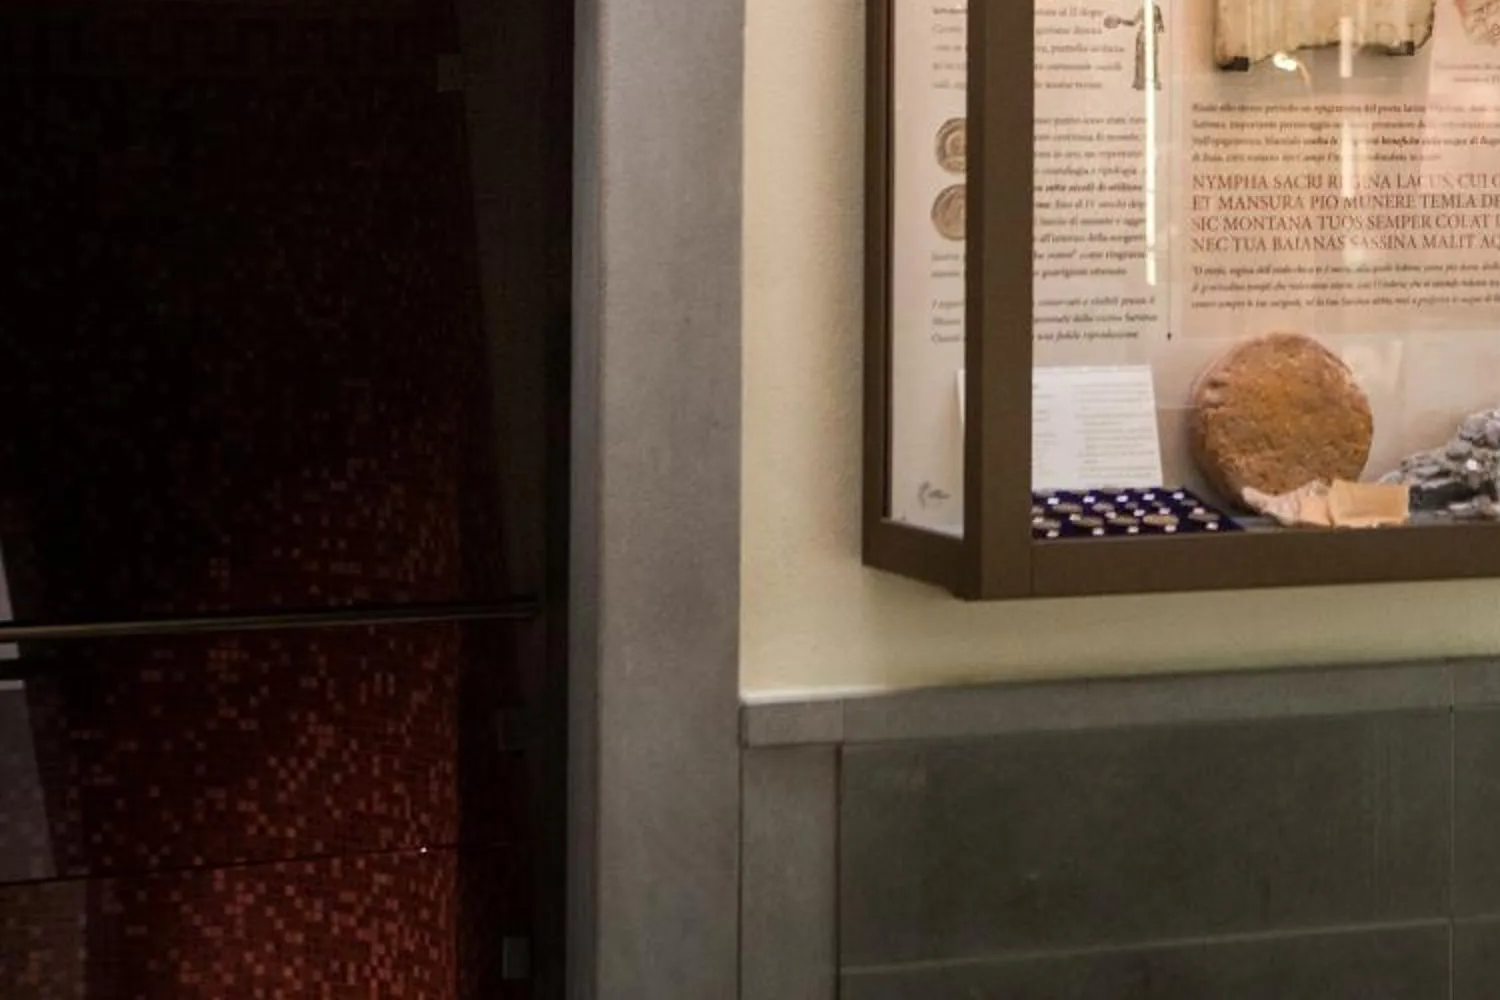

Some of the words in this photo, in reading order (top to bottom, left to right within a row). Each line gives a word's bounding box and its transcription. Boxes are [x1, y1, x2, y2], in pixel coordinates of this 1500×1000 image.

[1192, 174, 1268, 190] NYMPHA
[1457, 173, 1488, 189] CUI
[1192, 195, 1210, 211] ET
[1218, 195, 1304, 211] MANSURA
[1310, 195, 1339, 210] PIO
[1343, 194, 1417, 210] MUNERE
[1222, 216, 1313, 232] MONTANA
[1318, 215, 1362, 231] TUOS
[1367, 214, 1432, 230] SEMPER
[1435, 213, 1490, 229] COLAT
[1231, 236, 1267, 252] TUA
[1422, 233, 1478, 249] MALIT
